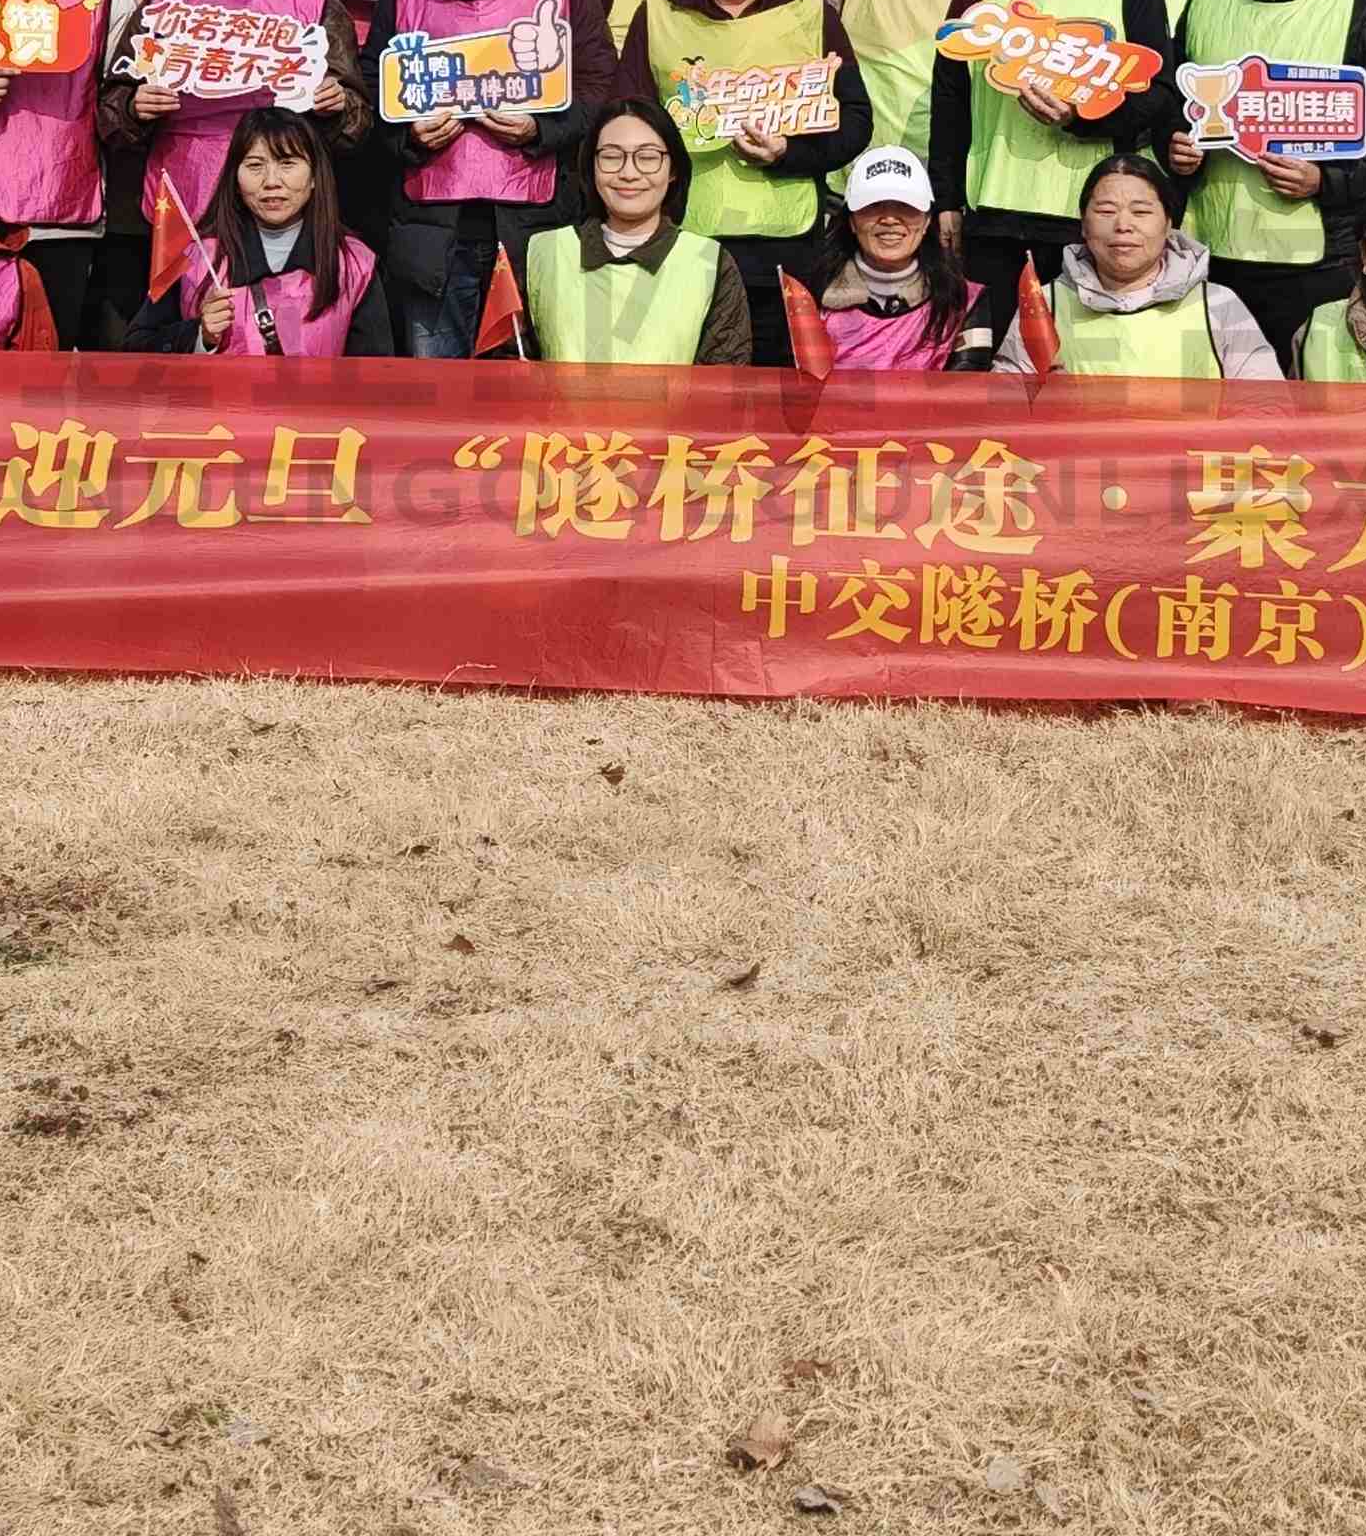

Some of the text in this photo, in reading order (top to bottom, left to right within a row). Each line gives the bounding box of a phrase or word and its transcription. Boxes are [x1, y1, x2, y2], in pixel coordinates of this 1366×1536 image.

[144, 2, 303, 53] 你若奔跑
[159, 40, 313, 91] 青春不老
[401, 53, 463, 83] 冲鸭！
[708, 64, 830, 103] 生命不息
[401, 75, 539, 111] 你是最棒的！
[1237, 90, 1356, 124] 再创佳绩
[715, 96, 838, 138] 运动不止
